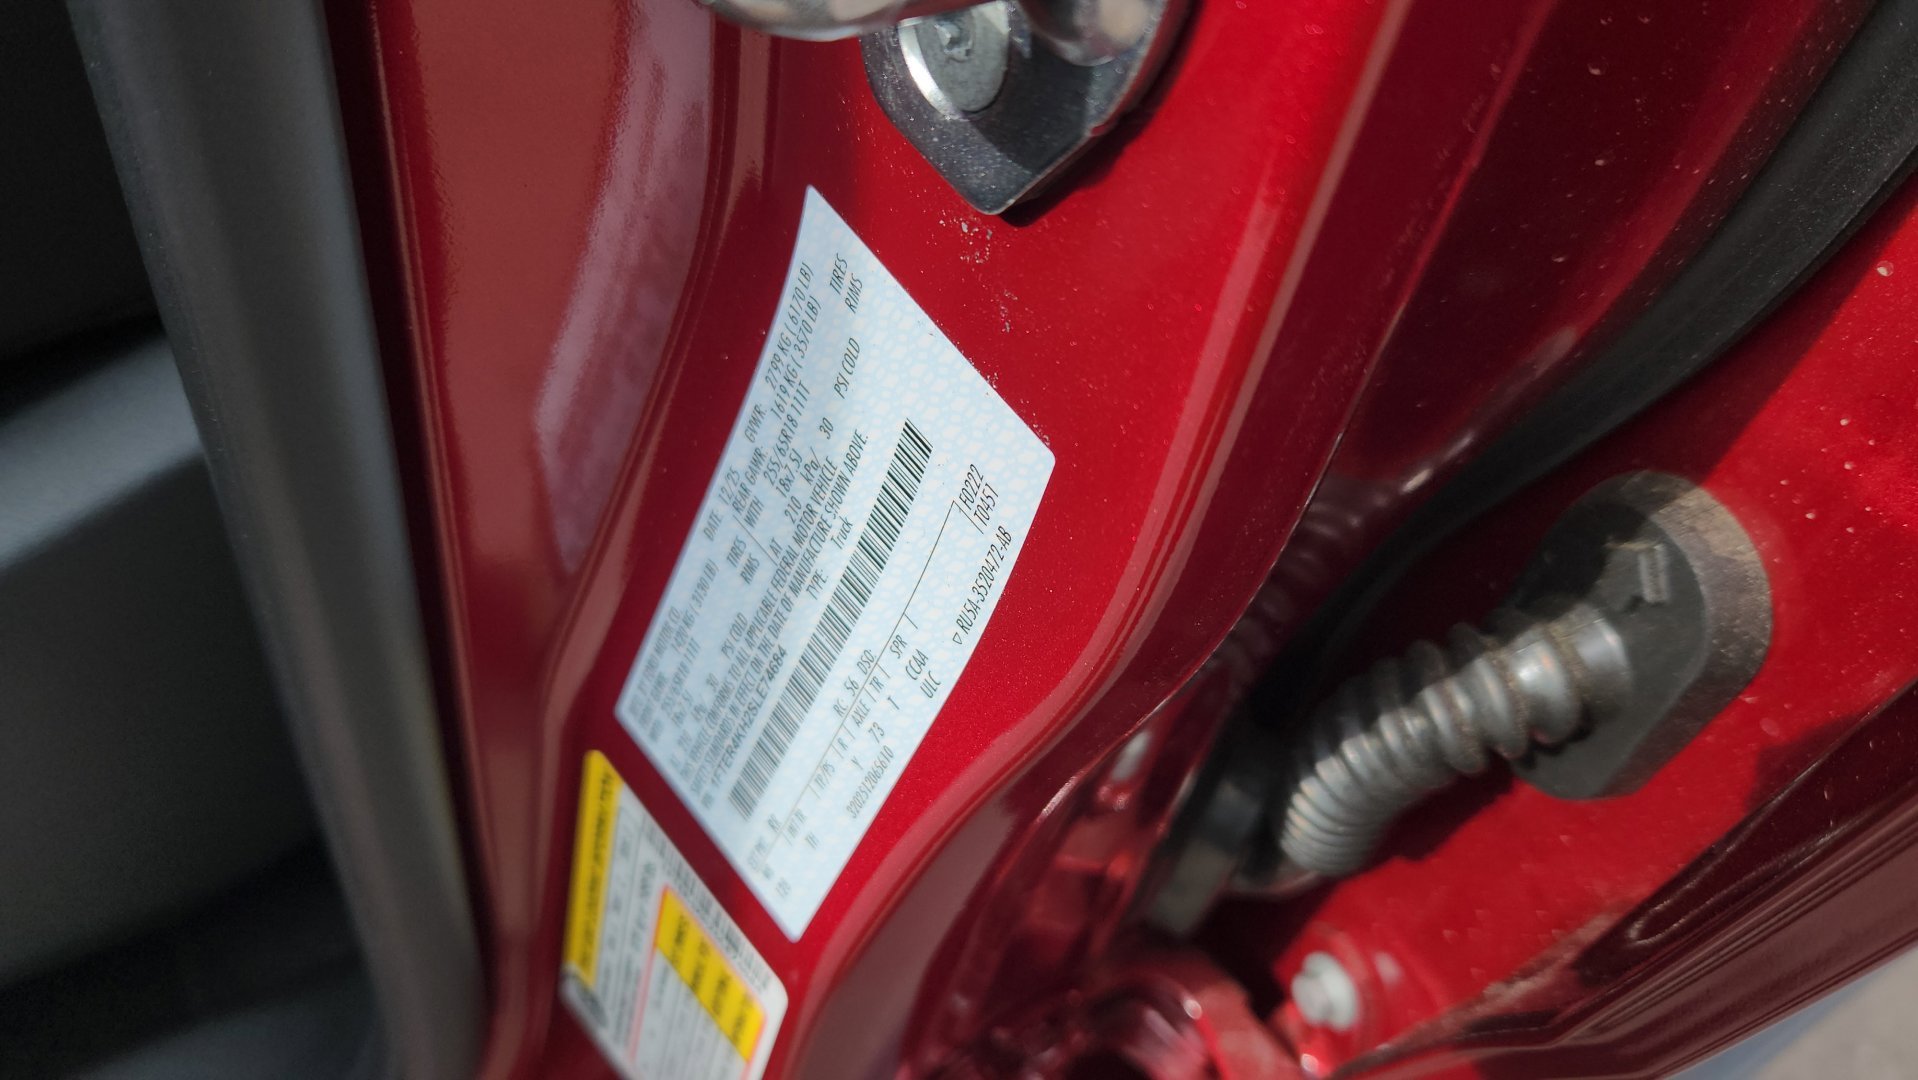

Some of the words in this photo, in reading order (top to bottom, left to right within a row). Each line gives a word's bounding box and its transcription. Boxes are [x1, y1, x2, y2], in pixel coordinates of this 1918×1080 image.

[828, 252, 848, 295] TIRES
[843, 272, 863, 314] RIMS
[763, 351, 785, 391] 2799
[776, 331, 792, 357] KG
[786, 285, 806, 327] 6170
[797, 261, 814, 290] LB)
[770, 383, 791, 421] 1619
[782, 363, 798, 388] KG
[792, 318, 814, 360] 3570
[804, 294, 821, 323] LB)
[840, 336, 861, 376] COLD
[832, 371, 850, 400] PSI
[743, 400, 767, 445] GVWR:
[762, 412, 799, 487] 255/65R18
[789, 379, 810, 417] 111T
[818, 416, 834, 440] 30
[841, 425, 869, 477] ABOVE.
[717, 465, 741, 506] 12/25
[731, 481, 751, 514] REAR
[743, 443, 768, 488] GAWR:
[774, 447, 803, 498] 18x7.5J
[783, 494, 802, 525] 210
[799, 445, 821, 486] kPa/
[743, 495, 764, 528] WITH
[823, 470, 851, 520] SHOWN
[972, 481, 999, 527] T0451
[725, 535, 747, 568] TIRES
[768, 536, 783, 559] AT
[787, 513, 833, 598] MANUFACTURE
[804, 566, 830, 602] TYPE:
[829, 515, 854, 550] Truck
[739, 552, 760, 585] RIMS
[955, 524, 1012, 635] RU5A-3520472-AB
[670, 624, 689, 653] 1420
[681, 610, 695, 629] KG
[690, 575, 710, 608] 3130
[702, 558, 718, 582] LB)
[704, 678, 735, 730] CONFORMS
[726, 662, 742, 682] TO
[734, 646, 751, 669] ALL
[743, 587, 778, 650] APPLICABLE
[769, 544, 800, 593] FEDERAL
[791, 502, 819, 549] MOTOR
[809, 455, 838, 507] VEHICLE
[779, 592, 794, 613] OF
[653, 620, 673, 657] MOTOR
[719, 637, 735, 659] PSI
[728, 611, 748, 643] COLD
[766, 607, 788, 640] DATE
[749, 656, 764, 675] ON
[756, 634, 775, 658] THE
[888, 633, 908, 660] SPR
[904, 648, 929, 681] CCAA
[733, 669, 757, 707] EFFECT
[843, 675, 860, 697] 56
[855, 646, 878, 676] DSO:
[868, 675, 884, 693] TR
[919, 669, 942, 699] ULC
[850, 698, 871, 728] AXLE
[886, 694, 900, 711] T
[836, 737, 848, 751] R
[867, 721, 885, 744] 73
[813, 760, 836, 790] TP/PS
[845, 744, 895, 819] 3202512065610
